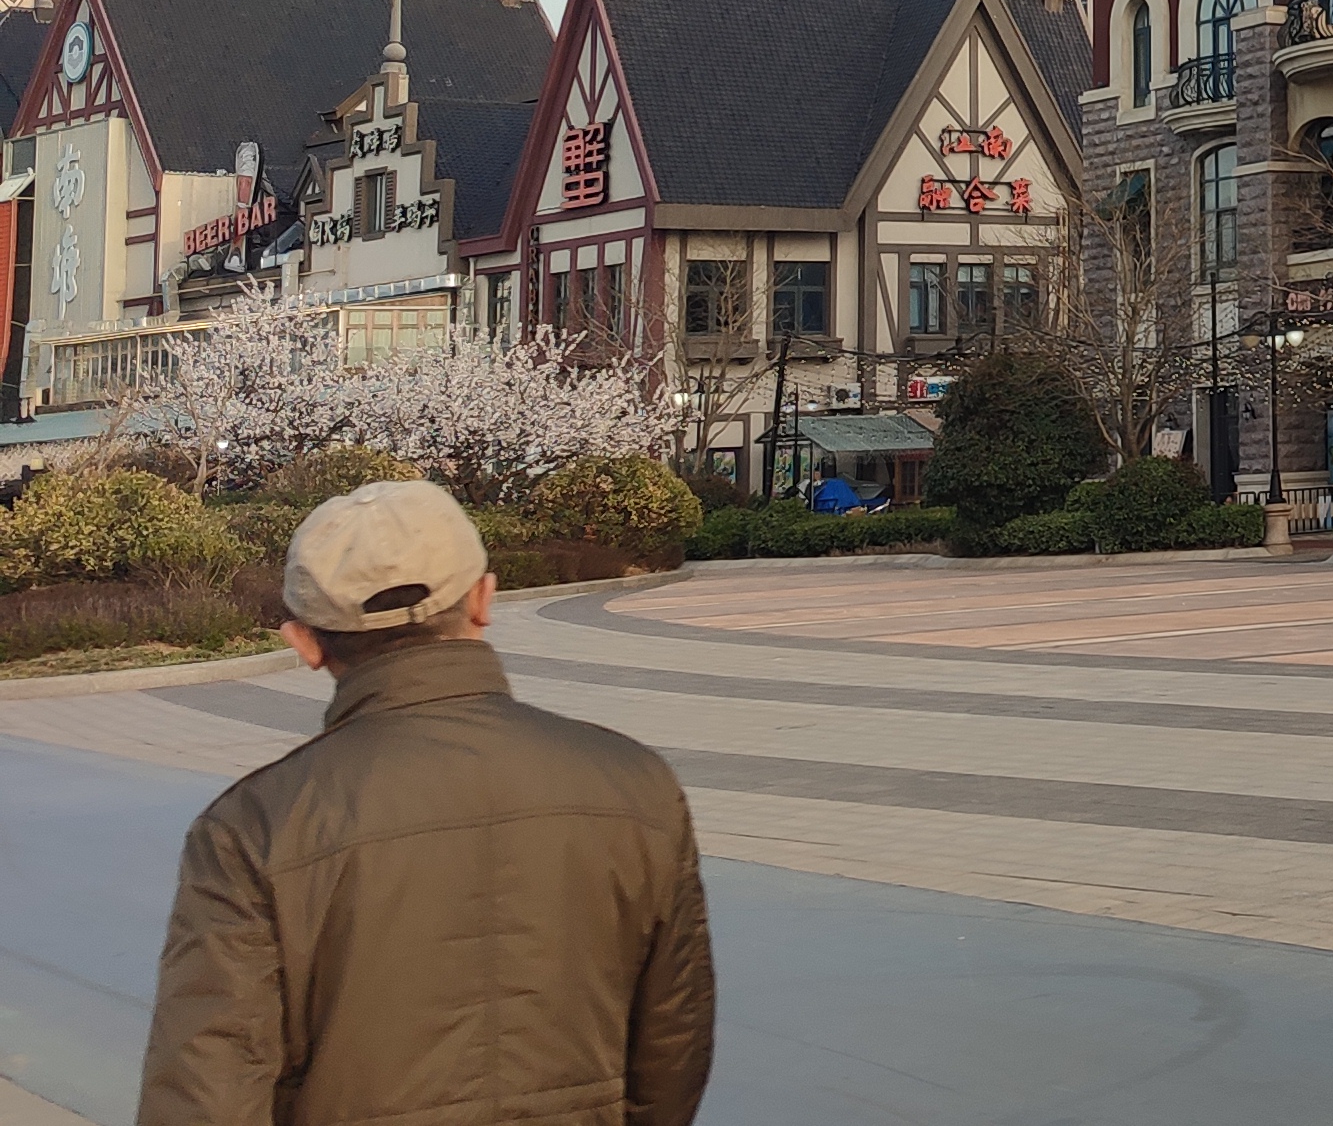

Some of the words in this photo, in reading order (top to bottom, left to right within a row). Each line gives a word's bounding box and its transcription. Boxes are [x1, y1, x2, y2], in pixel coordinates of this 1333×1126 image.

[939, 124, 1013, 160] 江南
[919, 174, 1033, 214] 融合菜
[183, 216, 231, 256] BEER
[235, 195, 278, 236] BAR
